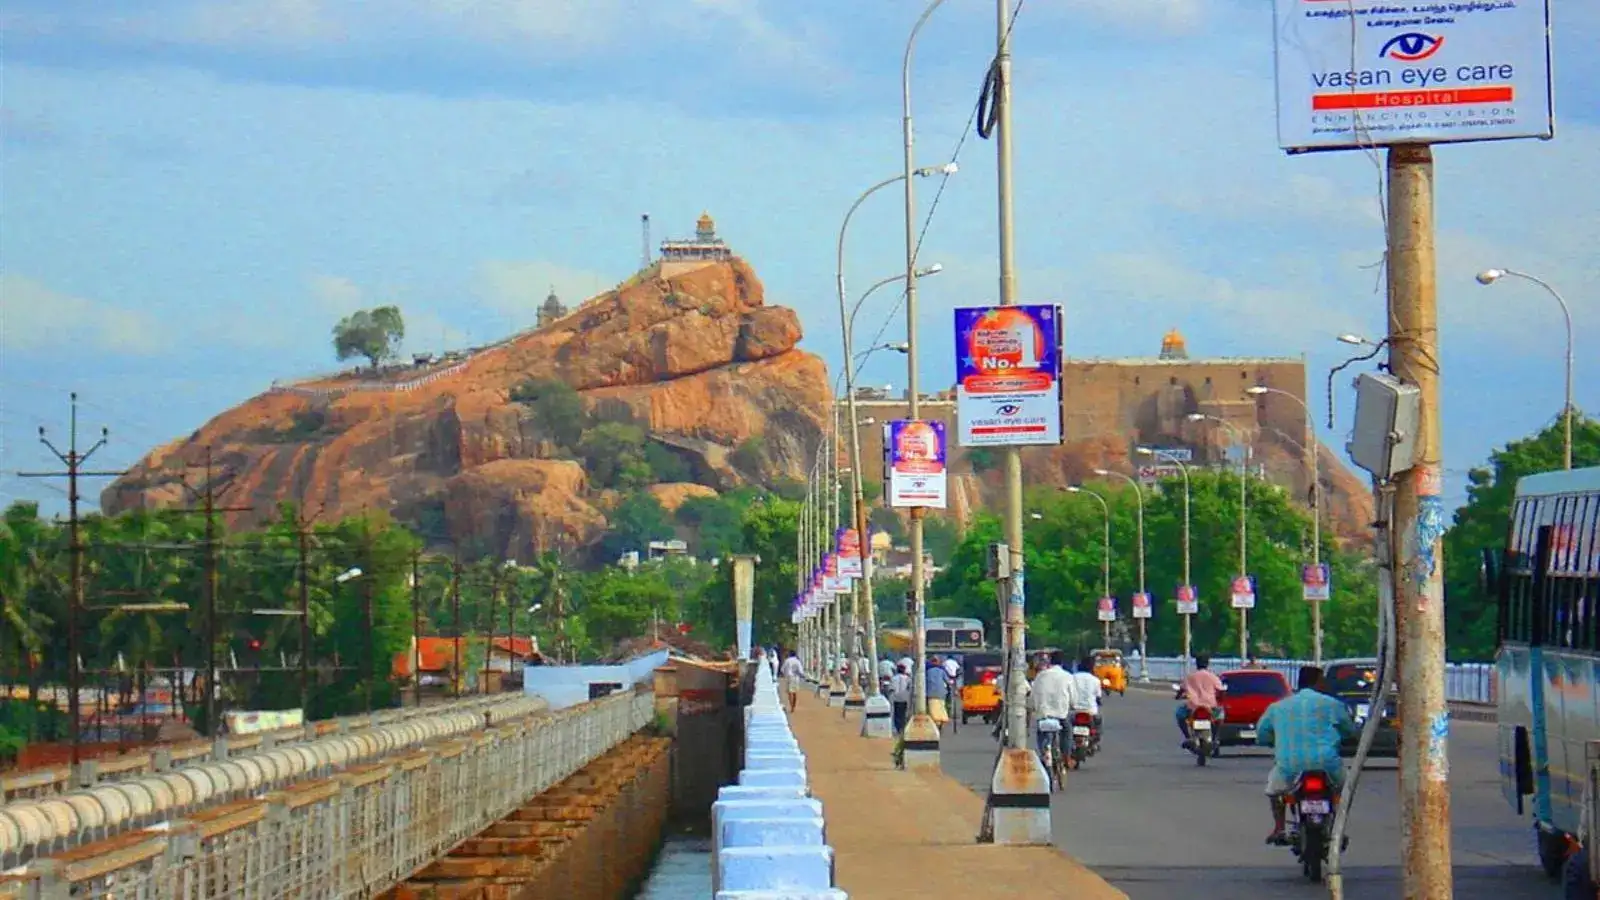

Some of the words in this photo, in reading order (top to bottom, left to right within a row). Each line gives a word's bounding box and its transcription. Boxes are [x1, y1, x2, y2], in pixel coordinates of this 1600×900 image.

[1312, 68, 1391, 88] vasan
[1401, 65, 1447, 87] eye
[1456, 63, 1513, 82] care
[1375, 90, 1459, 106] Hospital
